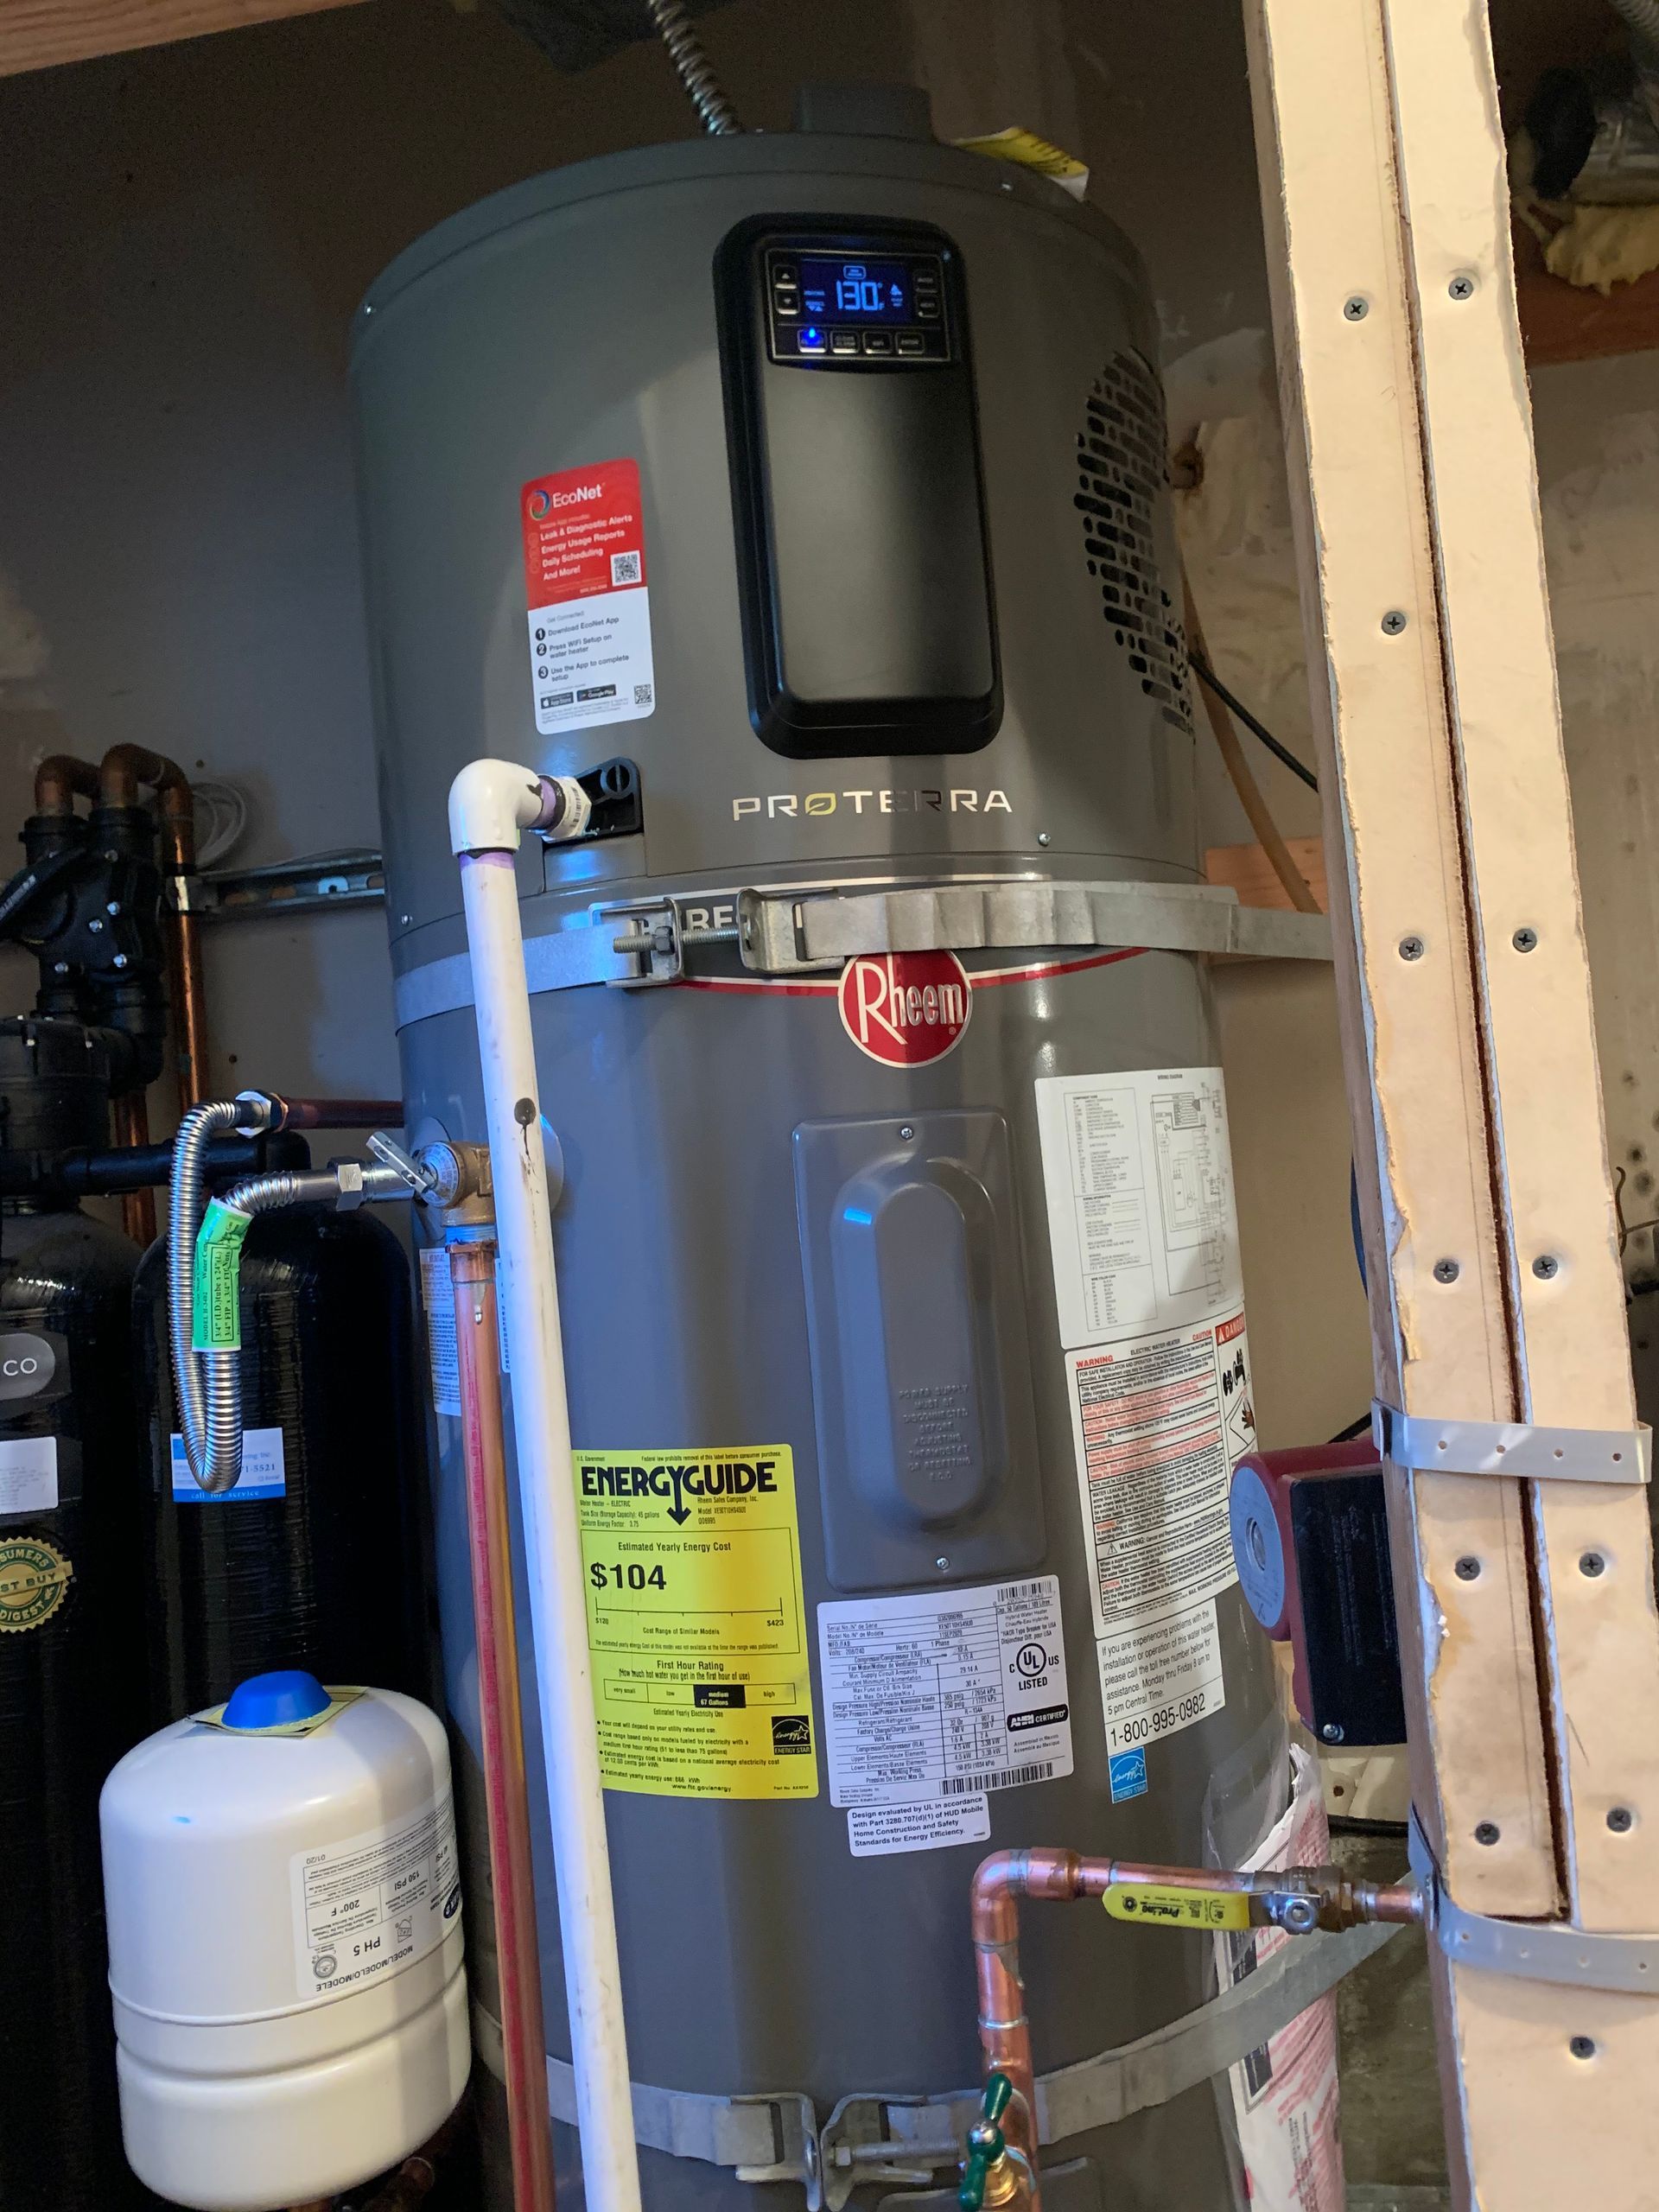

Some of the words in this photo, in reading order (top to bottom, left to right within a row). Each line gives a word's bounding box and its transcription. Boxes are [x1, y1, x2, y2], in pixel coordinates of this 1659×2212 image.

[553, 484, 602, 508] EcoNet
[541, 531, 557, 541] Leak
[567, 521, 607, 535] Diagnostic
[609, 515, 632, 525] Alerts
[542, 543, 566, 555] Energy
[569, 537, 592, 548] Usage
[594, 530, 625, 543] Reports
[543, 556, 559, 568] Daily
[562, 548, 602, 562] Scheduling
[543, 570, 557, 581] And
[549, 625, 578, 636] Download
[581, 620, 604, 629] EcoNet
[606, 616, 619, 625] App
[583, 636, 601, 645] Setup
[569, 646, 588, 655] heater
[576, 662, 588, 671] App
[598, 655, 629, 665] complete
[733, 790, 1013, 822] PROTERRA
[855, 952, 963, 1045] Rheem
[1192, 1329, 1211, 1340] CAUTION
[3, 1357, 37, 1376] CO
[1076, 1355, 1113, 1368] WARNING
[582, 1462, 777, 1497] ENERGYGUIDE
[619, 1542, 653, 1551] Estimated
[657, 1542, 681, 1553] Yearly
[683, 1542, 710, 1553] Energy
[27, 1573, 55, 1586] BUY
[590, 1562, 666, 1590] $104
[0, 1601, 44, 1621] DIGEST
[1103, 1647, 1106, 1656] If
[1108, 1645, 1119, 1656] you
[1133, 1628, 1168, 1647] experiencing
[1169, 1618, 1192, 1635] problems
[1192, 1613, 1201, 1623] with
[1103, 1655, 1136, 1671] installation
[1145, 1642, 1171, 1659] operation
[1172, 1639, 1177, 1648] of
[1178, 1636, 1186, 1645] this
[1187, 1630, 1200, 1641] water
[658, 1660, 674, 1669] First
[677, 1661, 695, 1669] Hour
[699, 1662, 724, 1671] Rating
[1009, 1664, 1015, 1673] C
[1023, 1651, 1039, 1669] UL
[1048, 1656, 1059, 1665] US
[1104, 1674, 1126, 1688] please
[1128, 1667, 1137, 1679] call
[1139, 1664, 1148, 1675] the
[1160, 1656, 1170, 1669] free
[1171, 1649, 1189, 1662] number
[1191, 1642, 1204, 1654] below
[739, 1673, 750, 1681] use)
[1142, 1674, 1165, 1688] Monday
[1166, 1669, 1176, 1679] thru
[1178, 1662, 1192, 1675] Friday
[1194, 1658, 1197, 1668] 8
[1198, 1656, 1205, 1665] am
[1019, 1677, 1048, 1690] LISTED
[1108, 1706, 1112, 1715] 5
[1114, 1702, 1123, 1715] pm
[1126, 1694, 1147, 1709] Central
[1111, 1693, 1205, 1746] 1-800-995-0982
[879, 1808, 912, 1816] evaluated
[944, 1797, 982, 1808] accordance
[876, 1825, 920, 1835] Construction
[938, 1820, 958, 1828] Safety
[931, 1827, 965, 1839] Efficiency.
[307, 1854, 326, 1864] 01/20
[394, 1878, 406, 1891] PSI
[409, 1870, 420, 1884] 150
[353, 1945, 360, 1956] 5
[365, 1937, 380, 1951] PH
